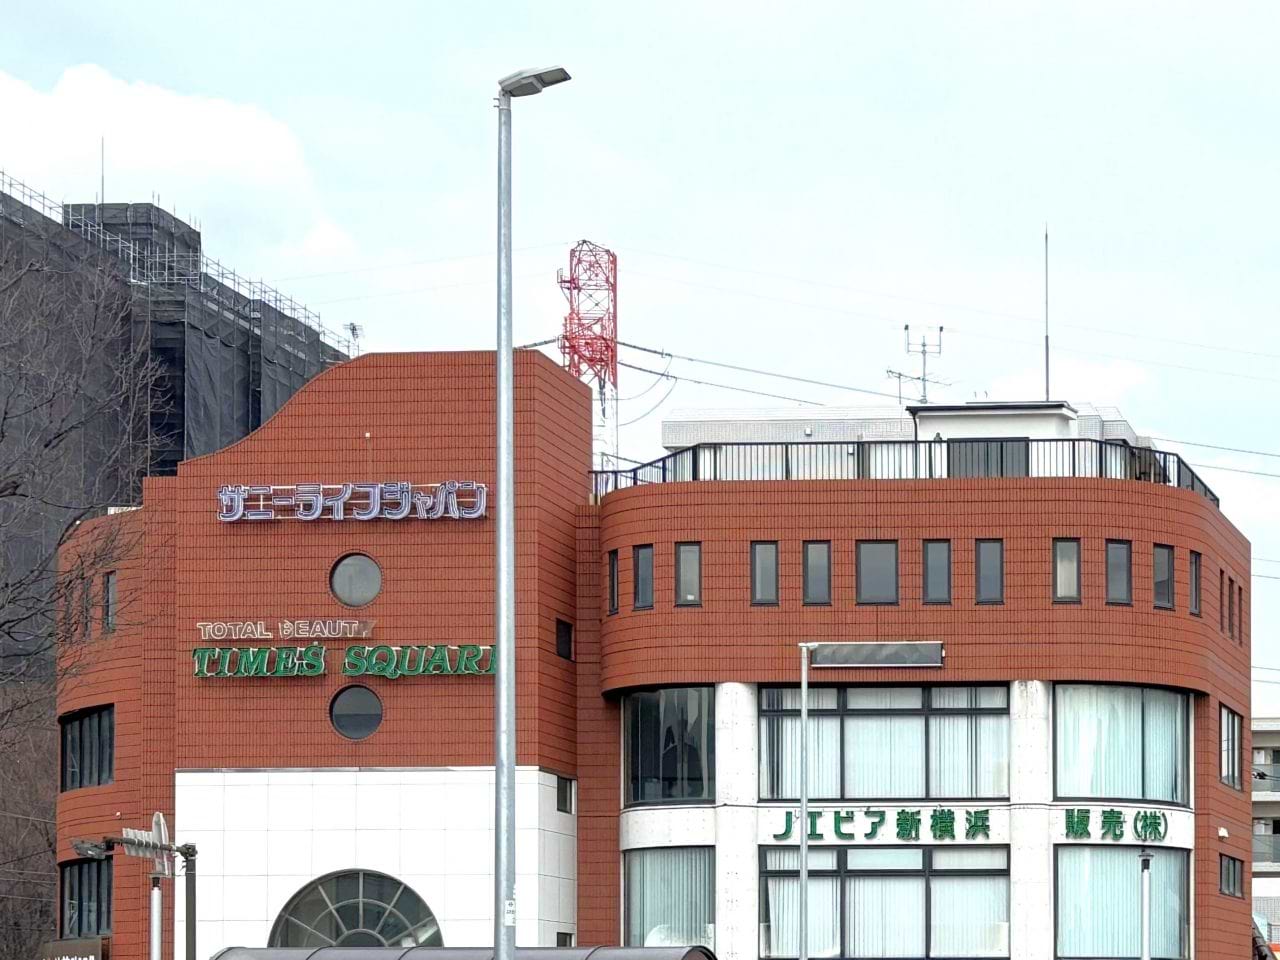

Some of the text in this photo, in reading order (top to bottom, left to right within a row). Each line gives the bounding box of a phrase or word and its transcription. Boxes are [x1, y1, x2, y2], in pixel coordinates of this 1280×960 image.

[218, 481, 487, 521] サニーライフジャパン
[197, 622, 273, 640] TOTAL
[192, 644, 326, 677] TIMES
[772, 808, 1169, 842] ノエビア新横浜 販売(株)
